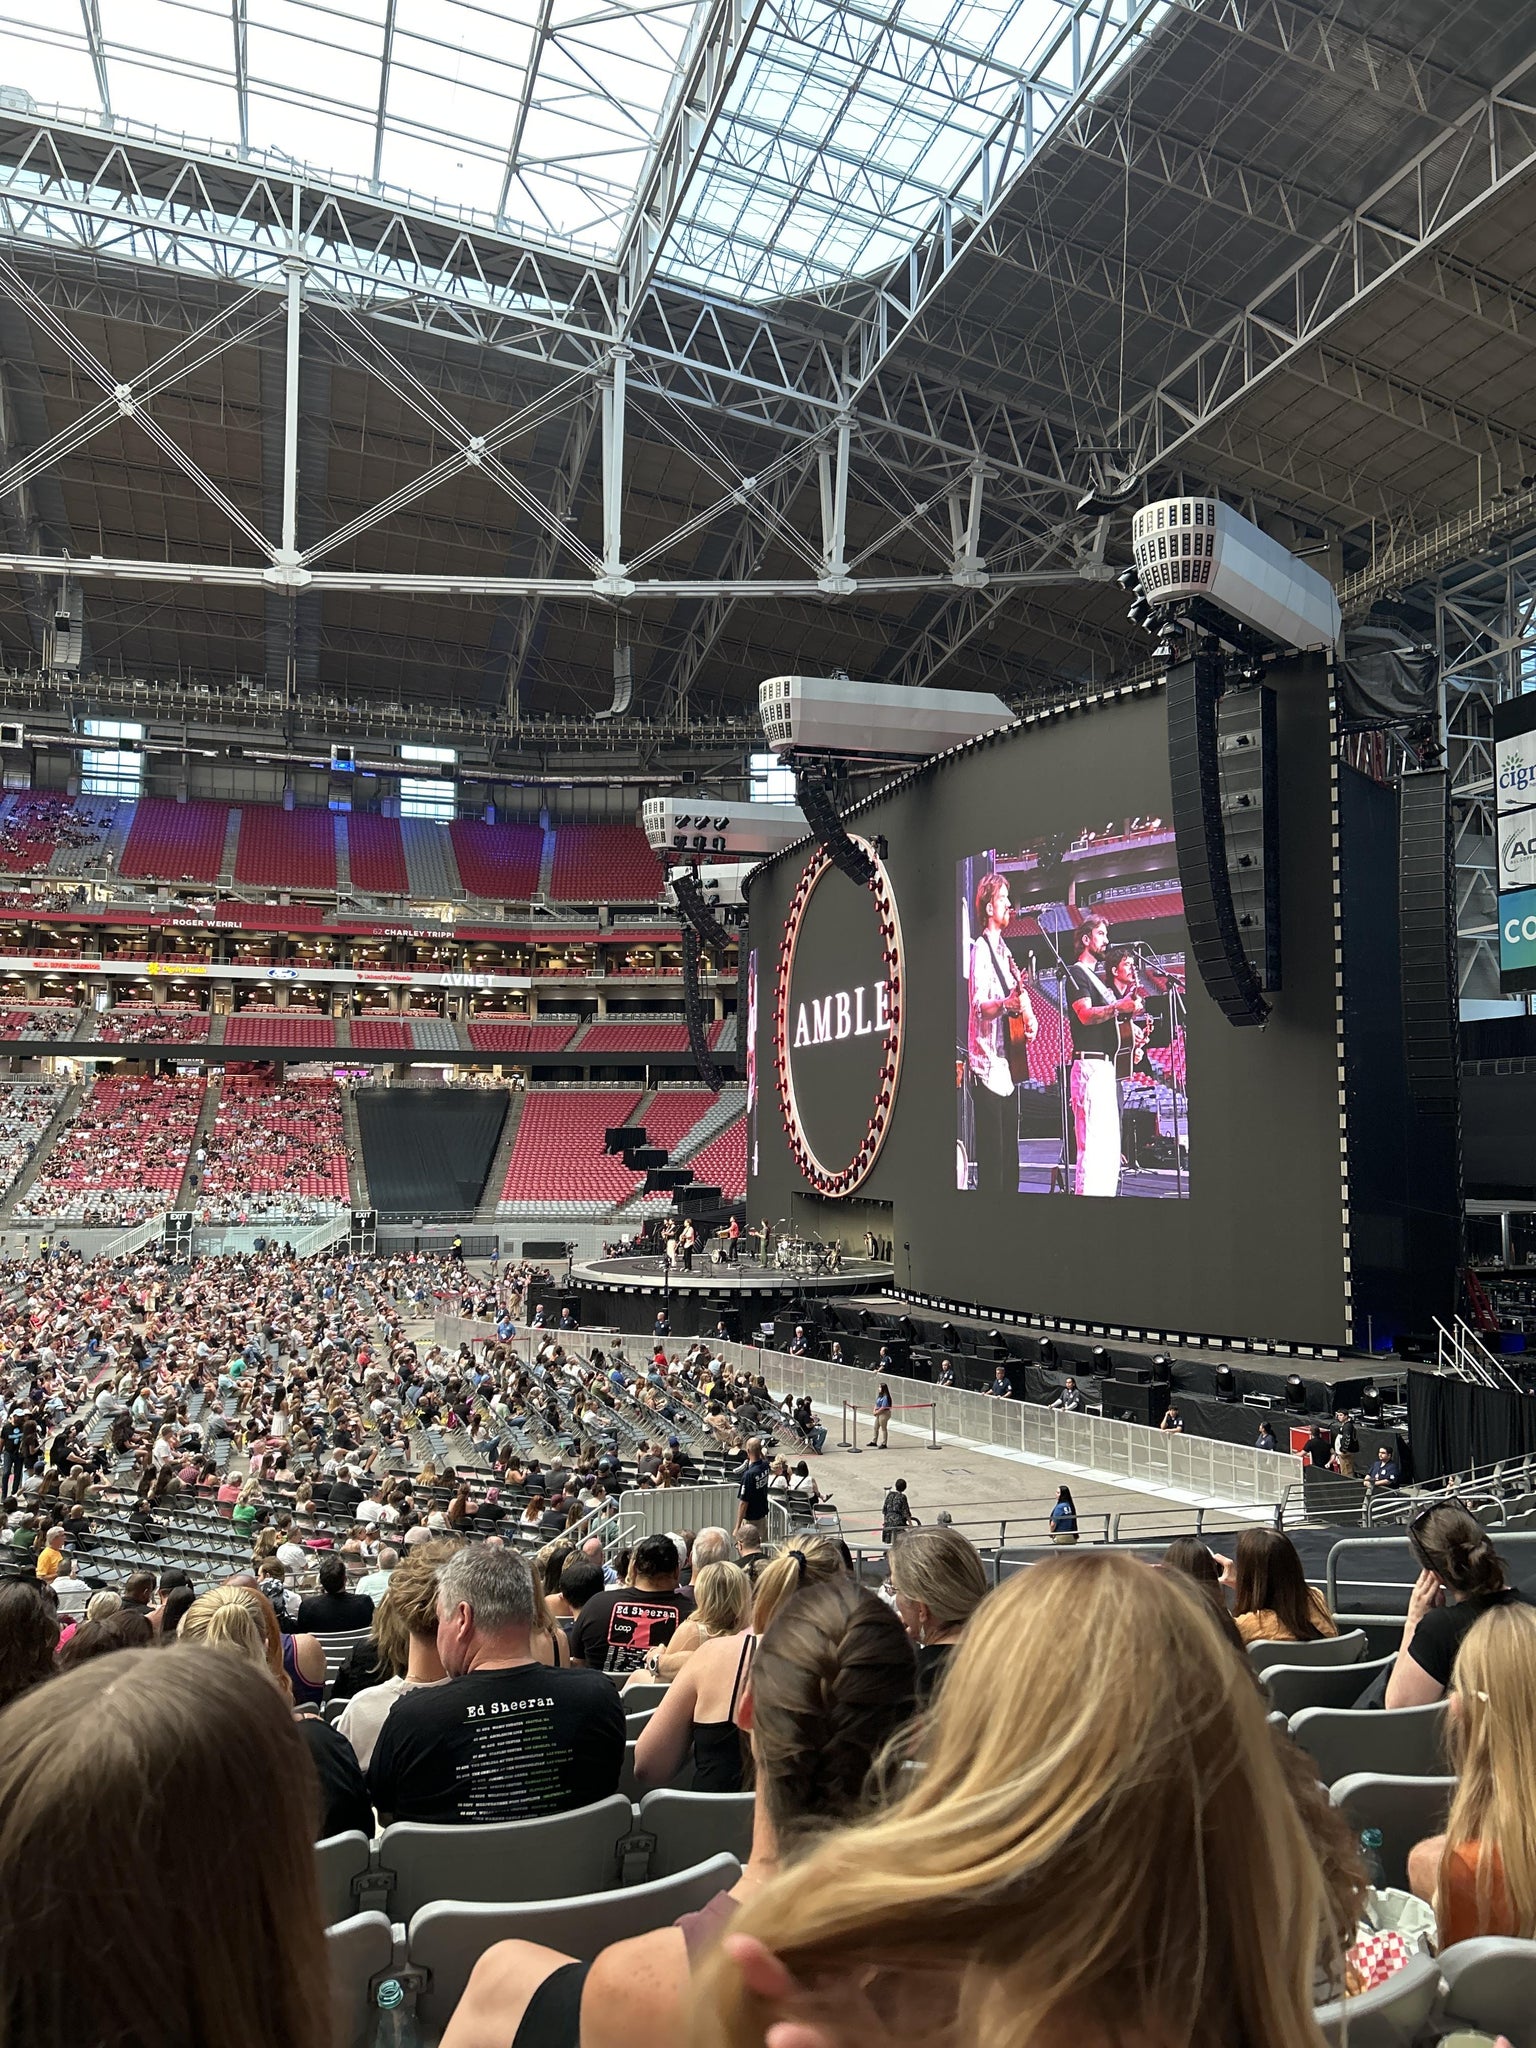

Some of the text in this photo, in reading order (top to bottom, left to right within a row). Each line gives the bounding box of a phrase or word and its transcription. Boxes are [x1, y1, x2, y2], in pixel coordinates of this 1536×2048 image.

[206, 920, 242, 928] WEHRLI
[1504, 915, 1536, 944] CO
[384, 929, 425, 937] CHARLEY
[440, 973, 495, 987] AVNET
[793, 981, 892, 1048] AMBLE
[616, 1605, 628, 1614] Ed
[466, 1697, 555, 1718] Ed Sheeran
